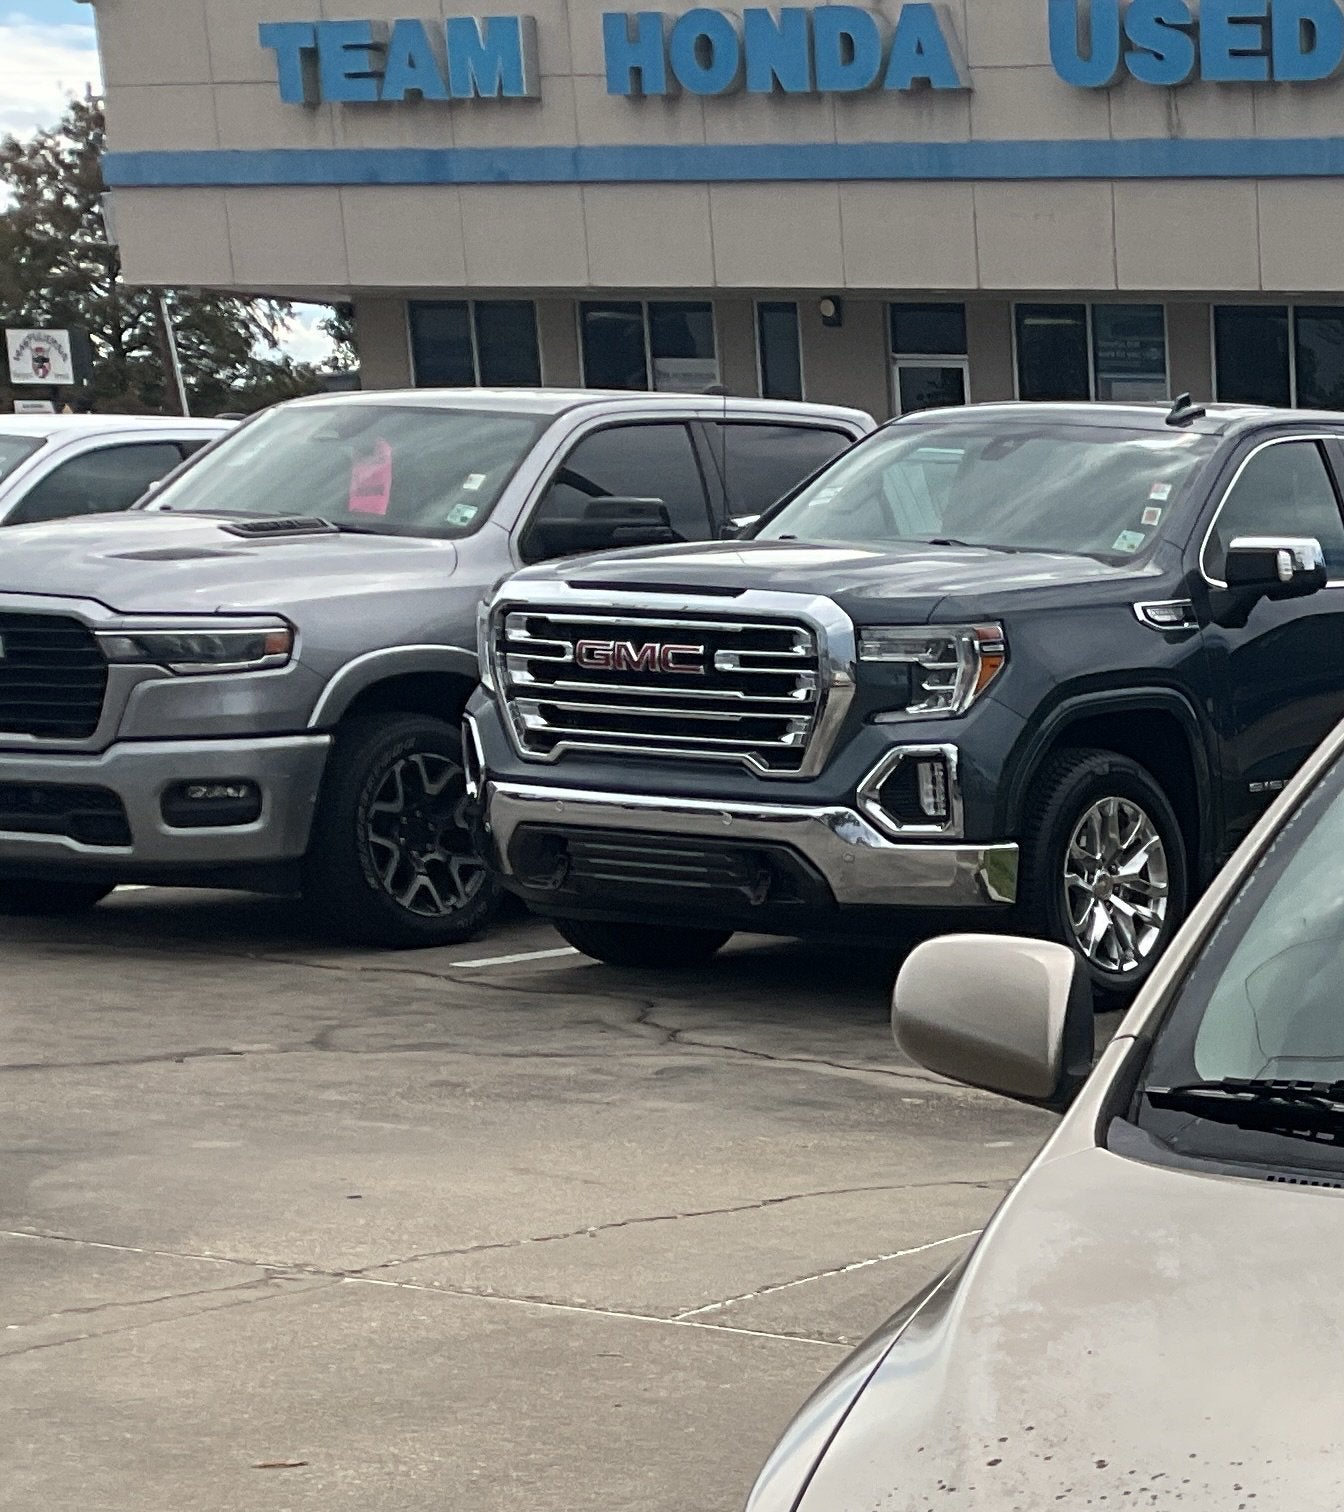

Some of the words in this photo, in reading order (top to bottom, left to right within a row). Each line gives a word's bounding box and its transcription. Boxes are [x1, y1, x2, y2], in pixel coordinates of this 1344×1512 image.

[259, 16, 537, 105] TEAM
[602, 3, 971, 95] HONDA
[576, 639, 705, 675] GMC
